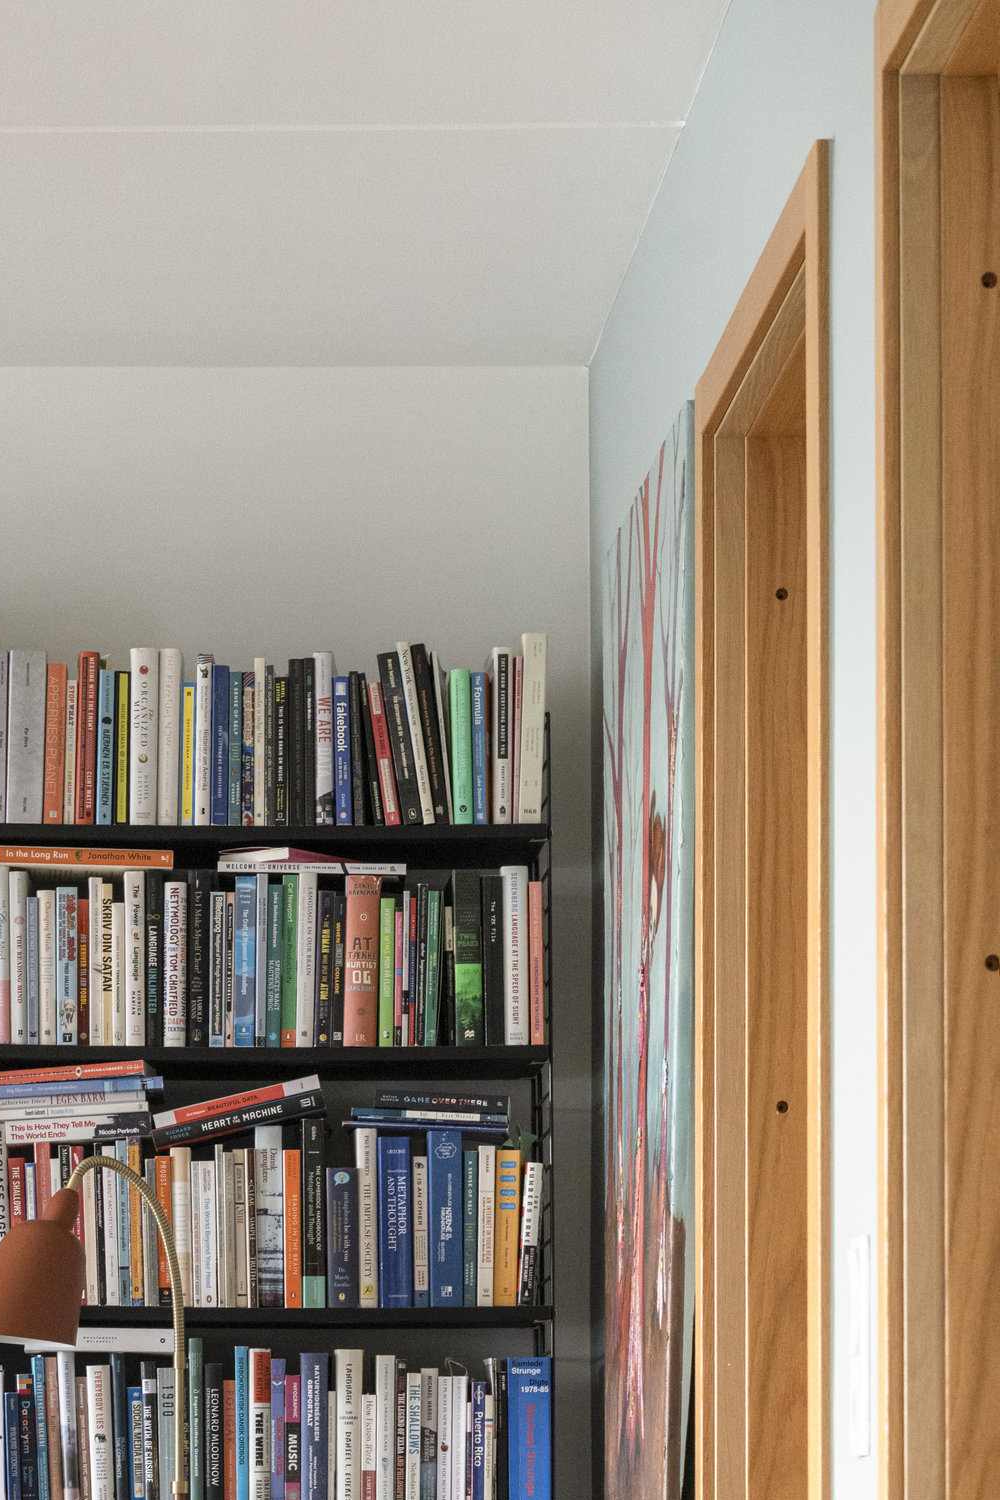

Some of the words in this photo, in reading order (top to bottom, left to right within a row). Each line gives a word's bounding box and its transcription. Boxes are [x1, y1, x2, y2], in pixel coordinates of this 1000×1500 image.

[474, 688, 482, 725] Formula
[336, 702, 346, 752] fakebook
[31, 851, 50, 859] Long
[88, 852, 125, 860] Jonathan
[103, 899, 112, 931] SKRIV
[170, 887, 179, 947] NETYMOLOGY
[103, 934, 112, 953] DIN
[348, 952, 376, 960] TÆNKE
[353, 938, 373, 950] AT
[103, 954, 112, 992] SATAN
[170, 953, 178, 971] TOM
[346, 961, 377, 969] HURTIGT
[352, 970, 371, 984] OG
[148, 968, 156, 1014] UNLIMITED
[169, 974, 178, 1016] CHATFIELD
[52, 1122, 69, 1130] They
[201, 1118, 229, 1131] HEART
[242, 1105, 283, 1120] MACHINE
[388, 1176, 396, 1196] AND
[398, 1176, 407, 1234] METAPHOR
[388, 1198, 397, 1251] THOUGHT
[511, 1367, 542, 1375] Strunge
[530, 1378, 550, 1387] Digte
[94, 1371, 104, 1413] EVERYBODY
[410, 1384, 420, 1400] THE
[211, 1389, 219, 1431] LEONARD
[256, 1413, 264, 1432] THE
[526, 1404, 537, 1447] Michael
[21, 1401, 30, 1454] Dataclysm
[409, 1402, 420, 1454] SHALLOWS
[474, 1411, 483, 1442] Puerto
[211, 1433, 219, 1486] MLODINOW
[256, 1434, 264, 1466] WIRE
[288, 1434, 298, 1471] MUSIC
[474, 1444, 482, 1467] Rico
[526, 1449, 537, 1496] Strunge
